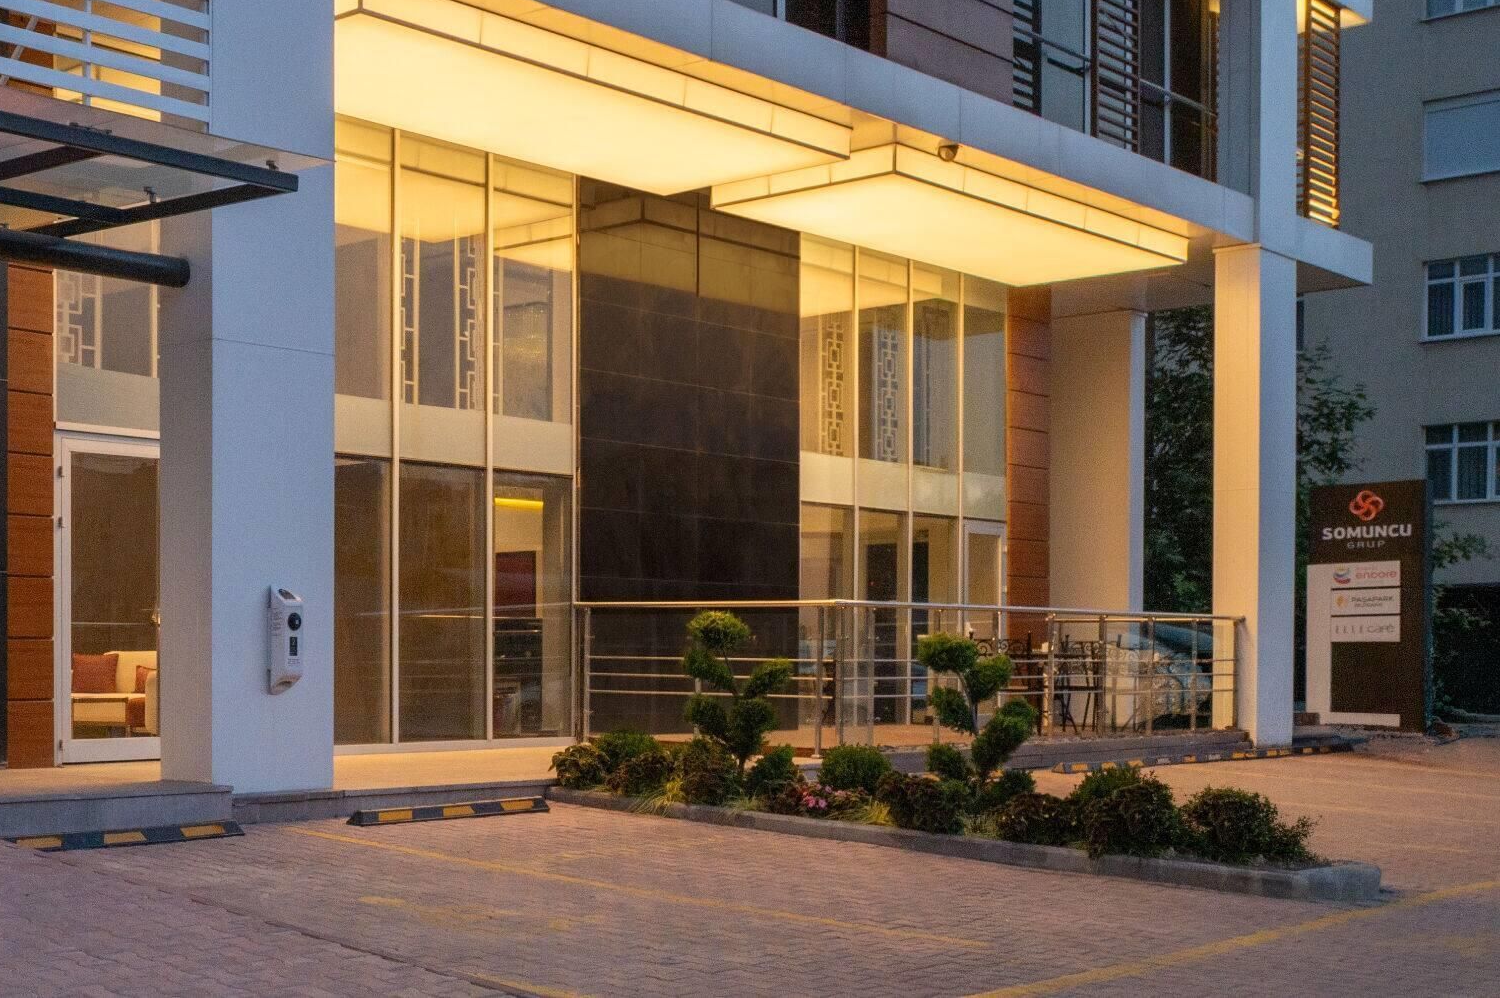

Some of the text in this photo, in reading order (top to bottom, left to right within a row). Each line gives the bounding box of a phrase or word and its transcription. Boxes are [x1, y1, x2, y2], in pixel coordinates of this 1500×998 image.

[1322, 524, 1412, 540] SOMUNCU
[1347, 540, 1385, 548] GRUP
[1355, 570, 1397, 579] encore
